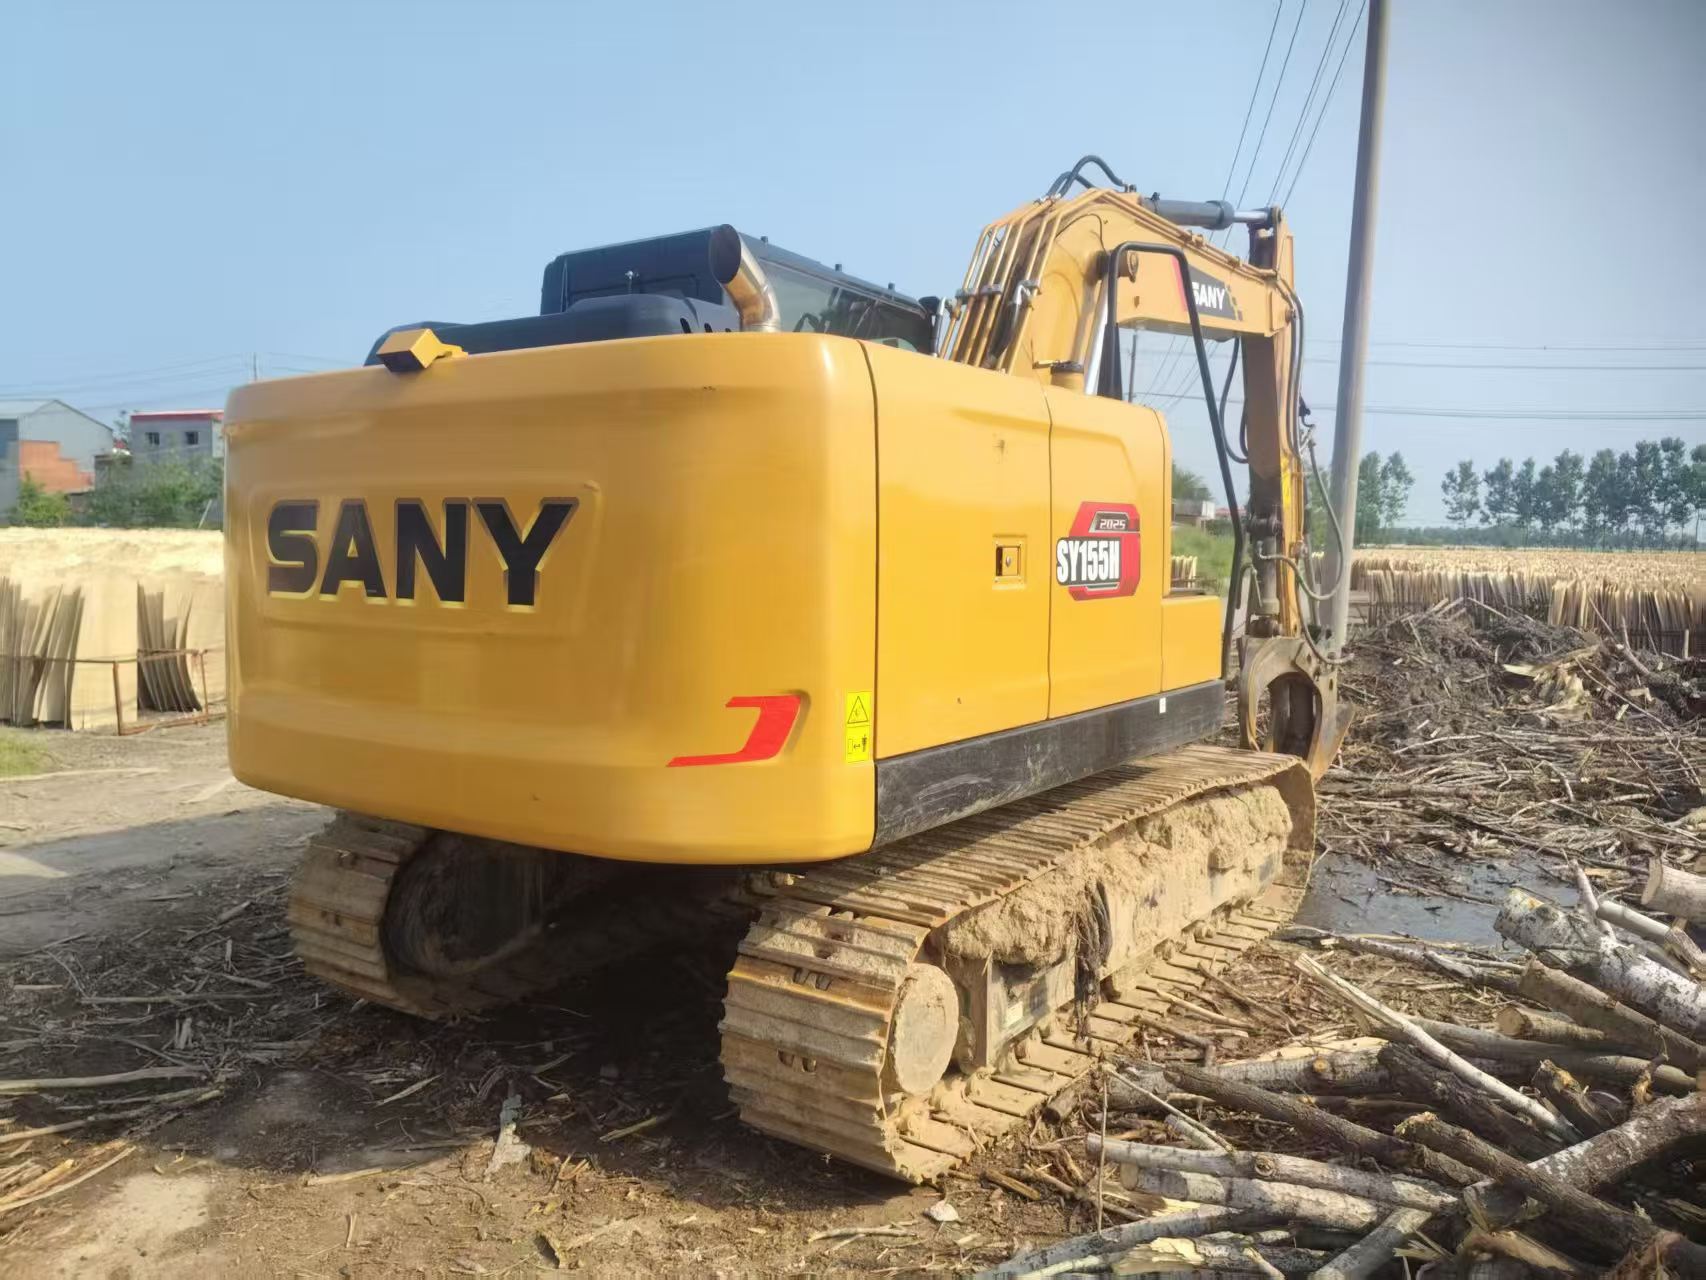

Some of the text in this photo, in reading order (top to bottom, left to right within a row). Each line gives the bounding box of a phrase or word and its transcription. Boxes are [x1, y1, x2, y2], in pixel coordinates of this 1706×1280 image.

[1099, 518, 1126, 530] 2025
[267, 497, 580, 613] SANY
[1056, 539, 1120, 583] SY155H
